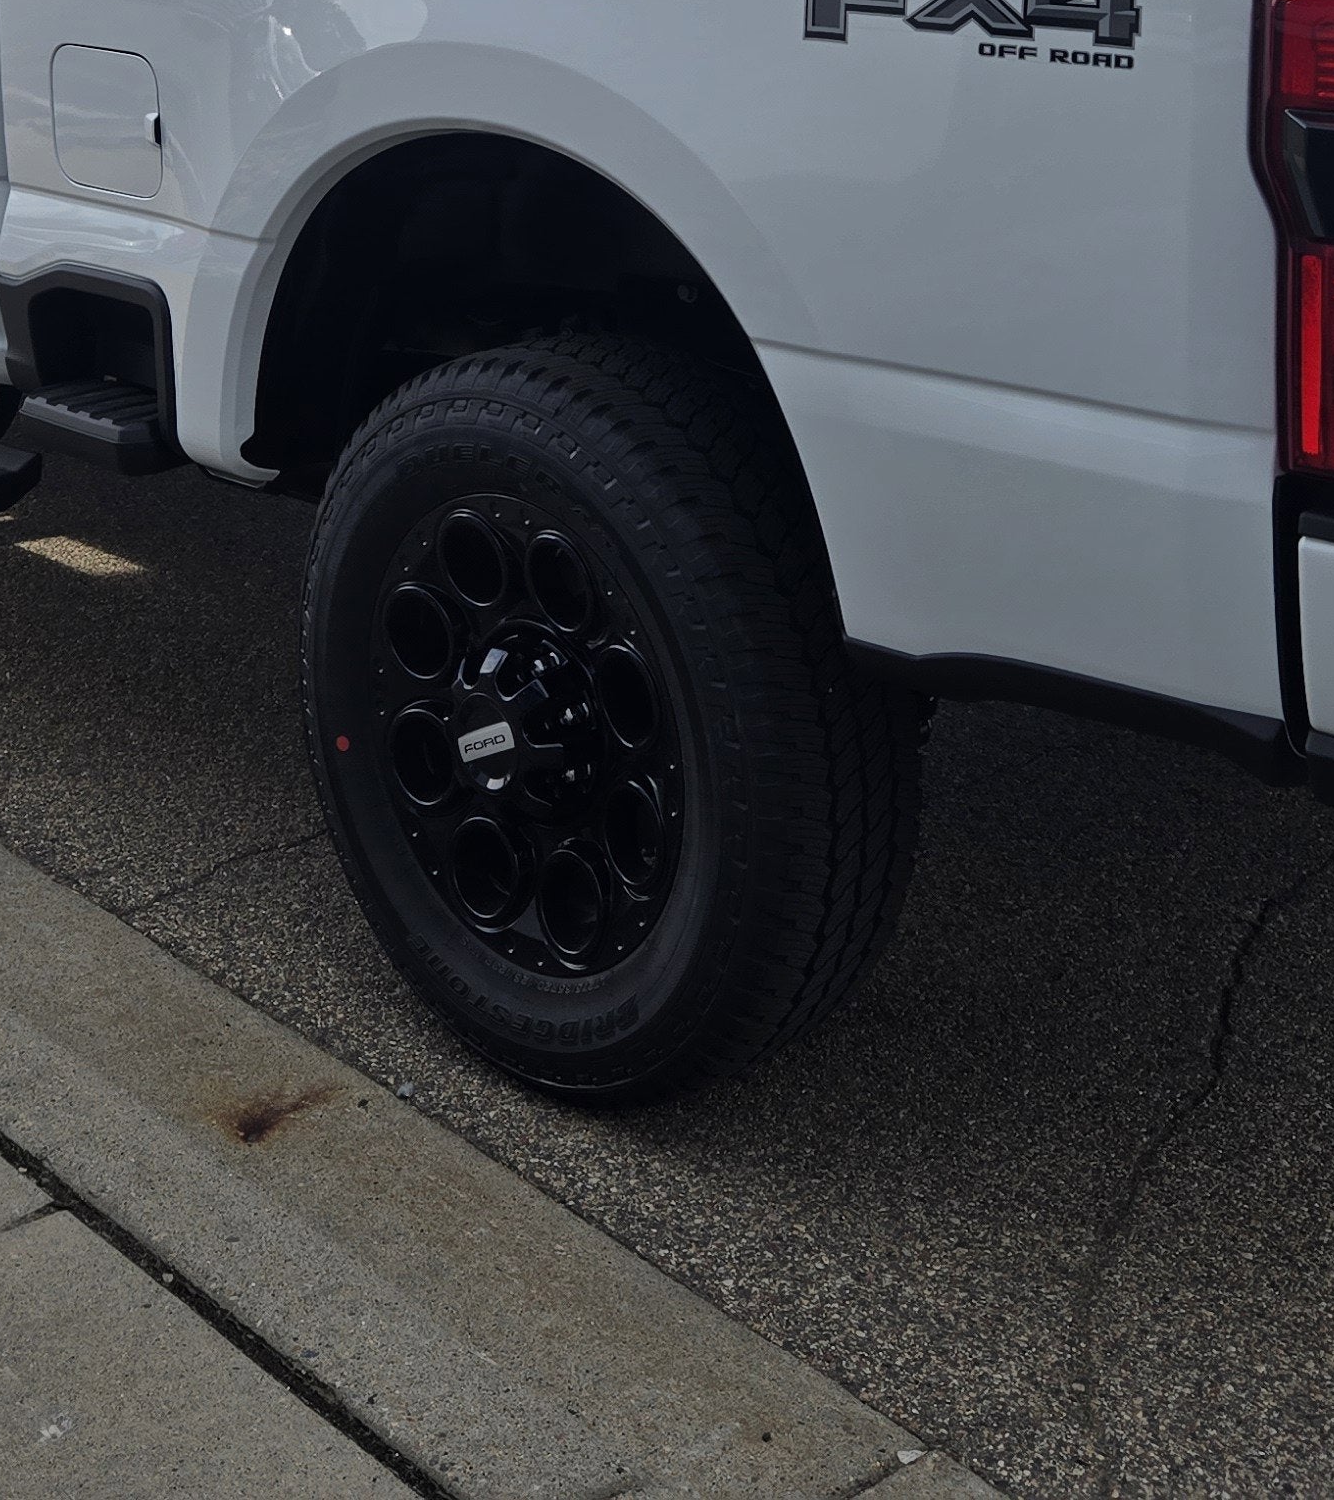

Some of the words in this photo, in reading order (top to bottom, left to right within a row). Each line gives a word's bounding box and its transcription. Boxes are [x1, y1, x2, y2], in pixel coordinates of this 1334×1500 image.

[978, 42, 1038, 60] OFF
[1049, 47, 1135, 70] ROAD
[464, 734, 506, 754] FORD
[407, 933, 641, 1047] BRIDGESTONE
